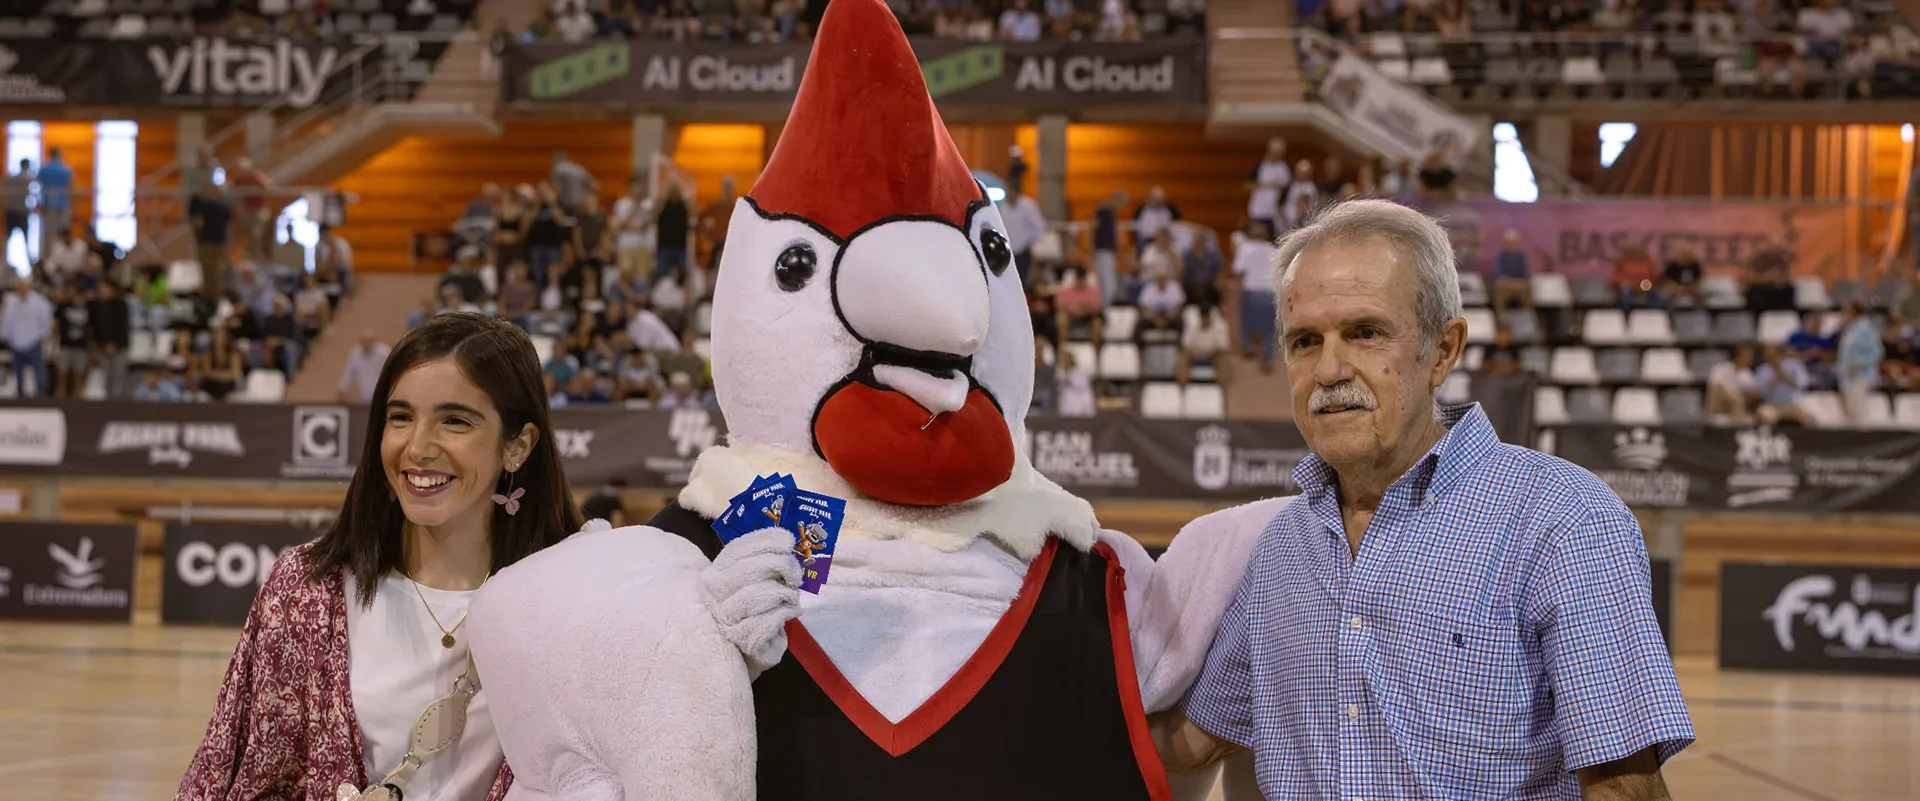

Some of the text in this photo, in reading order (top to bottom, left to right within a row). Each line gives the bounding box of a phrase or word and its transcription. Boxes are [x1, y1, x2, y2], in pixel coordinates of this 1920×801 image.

[148, 37, 335, 107] vitaly
[688, 55, 796, 91] Cloud
[1063, 55, 1174, 91] Cloud
[1035, 430, 1092, 452] SAN
[1035, 451, 1139, 479] MIGUEL
[807, 568, 818, 580] VR
